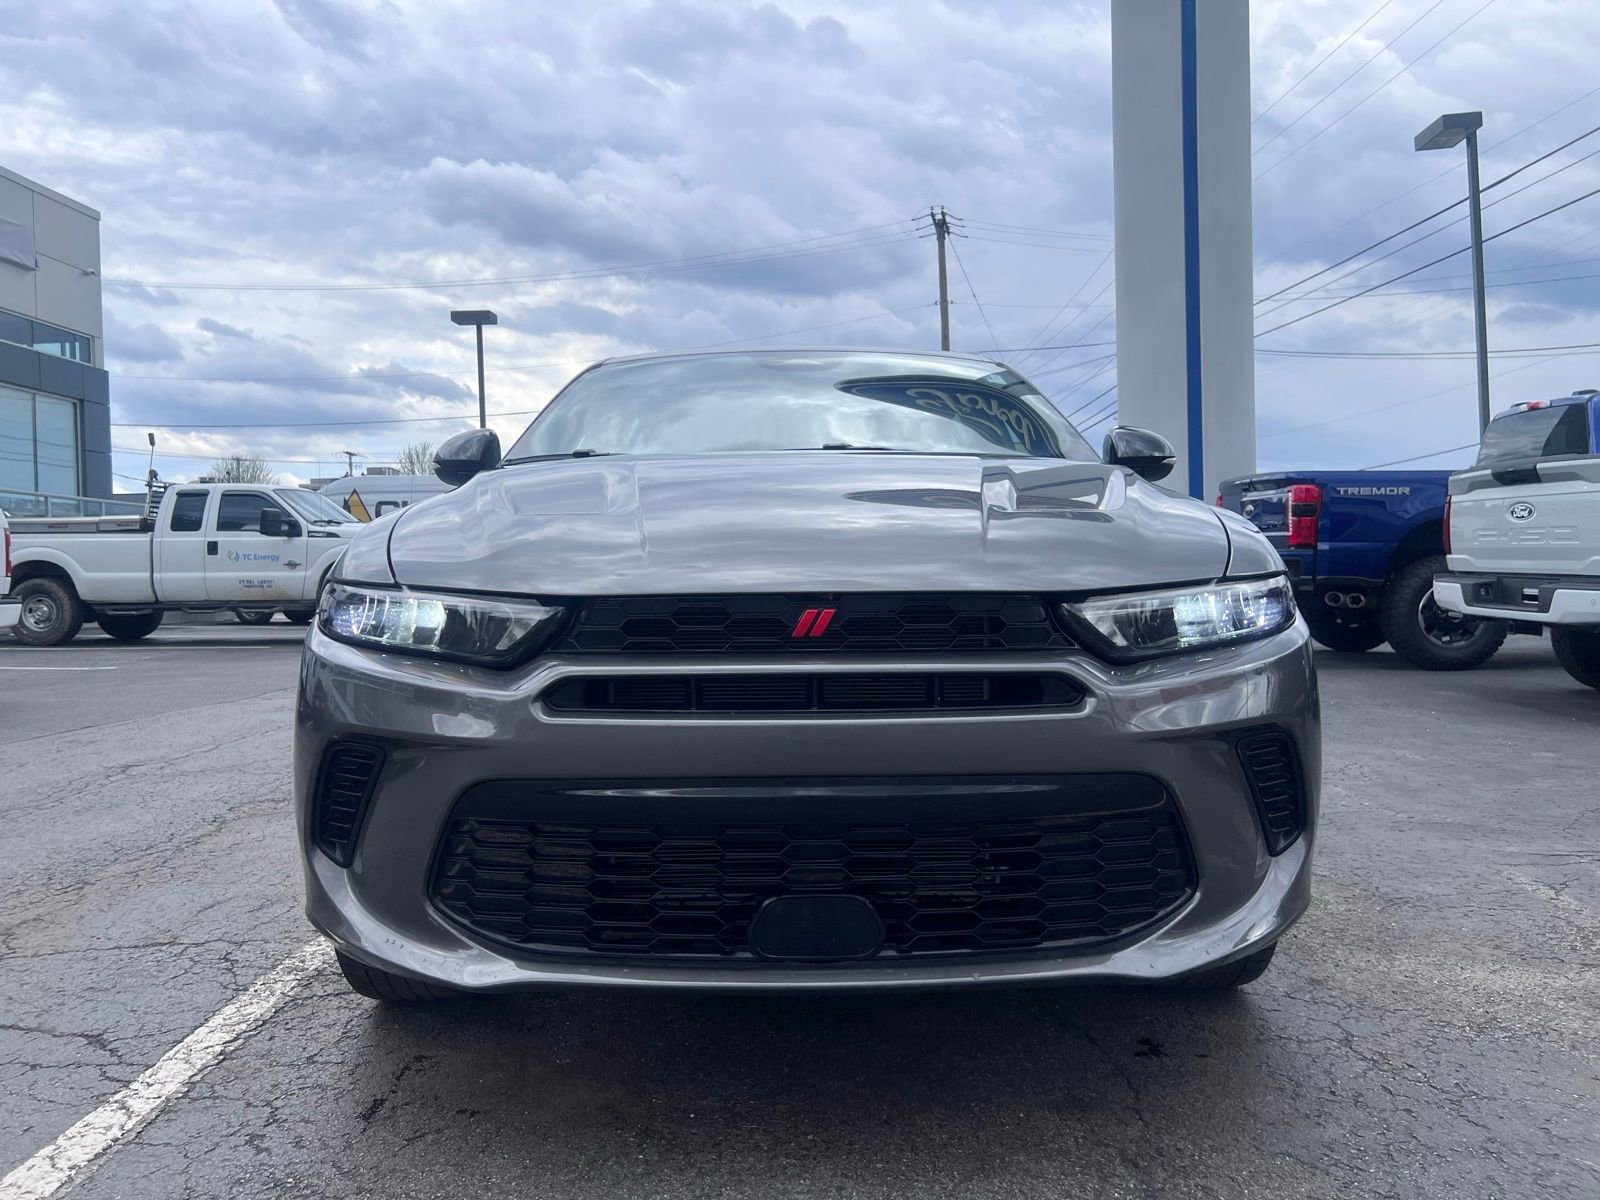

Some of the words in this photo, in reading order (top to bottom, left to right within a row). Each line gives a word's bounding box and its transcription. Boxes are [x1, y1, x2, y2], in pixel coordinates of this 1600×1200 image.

[1337, 487, 1411, 496] TREMOR
[1510, 504, 1532, 518] Ford
[1472, 527, 1581, 545] F-150
[254, 554, 280, 562] Energy
